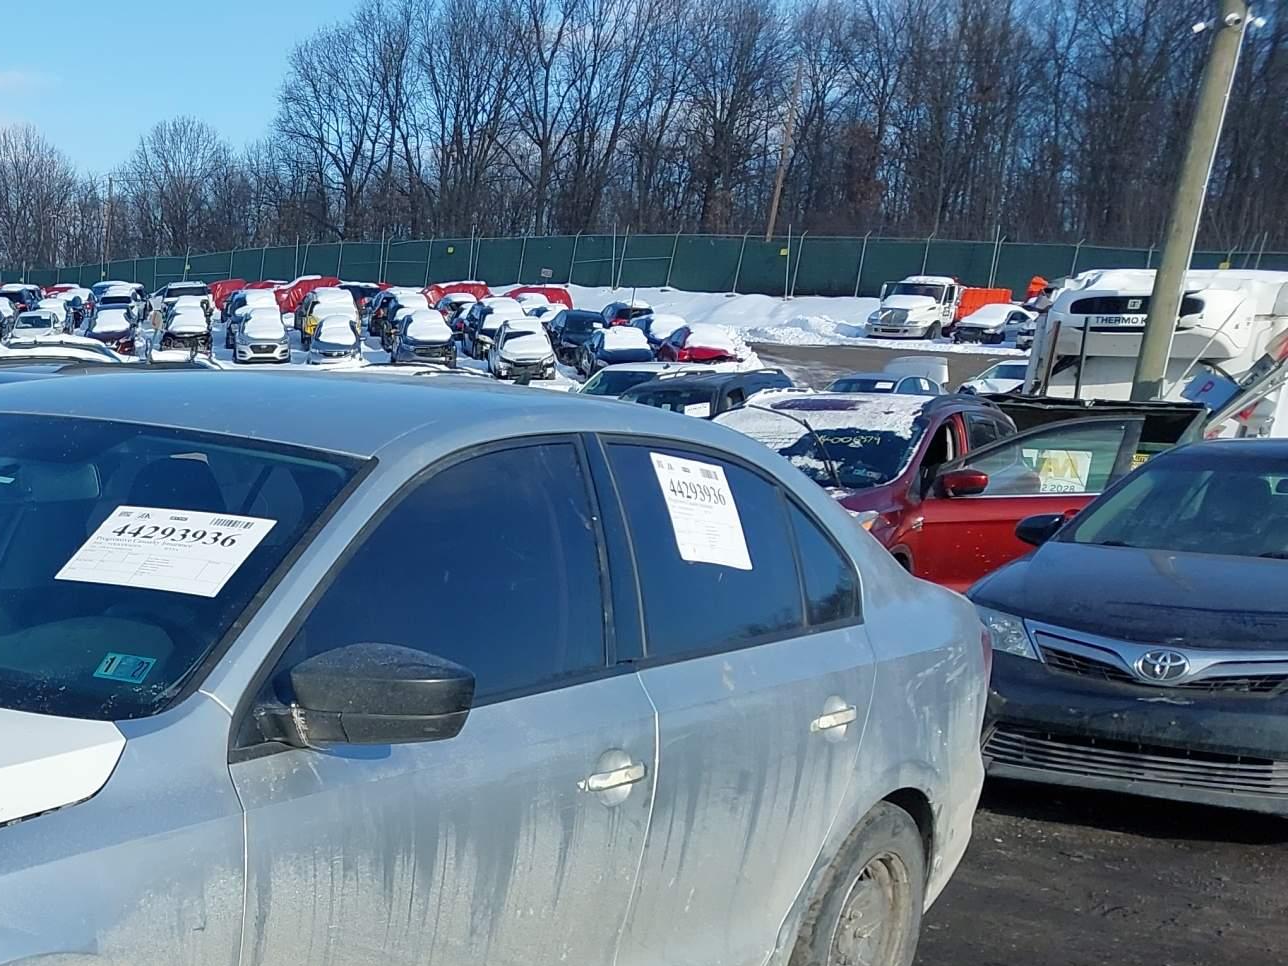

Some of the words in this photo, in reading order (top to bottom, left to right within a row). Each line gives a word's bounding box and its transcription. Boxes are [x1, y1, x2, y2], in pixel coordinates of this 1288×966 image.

[1096, 316, 1139, 324] THERMO
[670, 478, 726, 505] 44293936
[112, 523, 241, 547] 44293936
